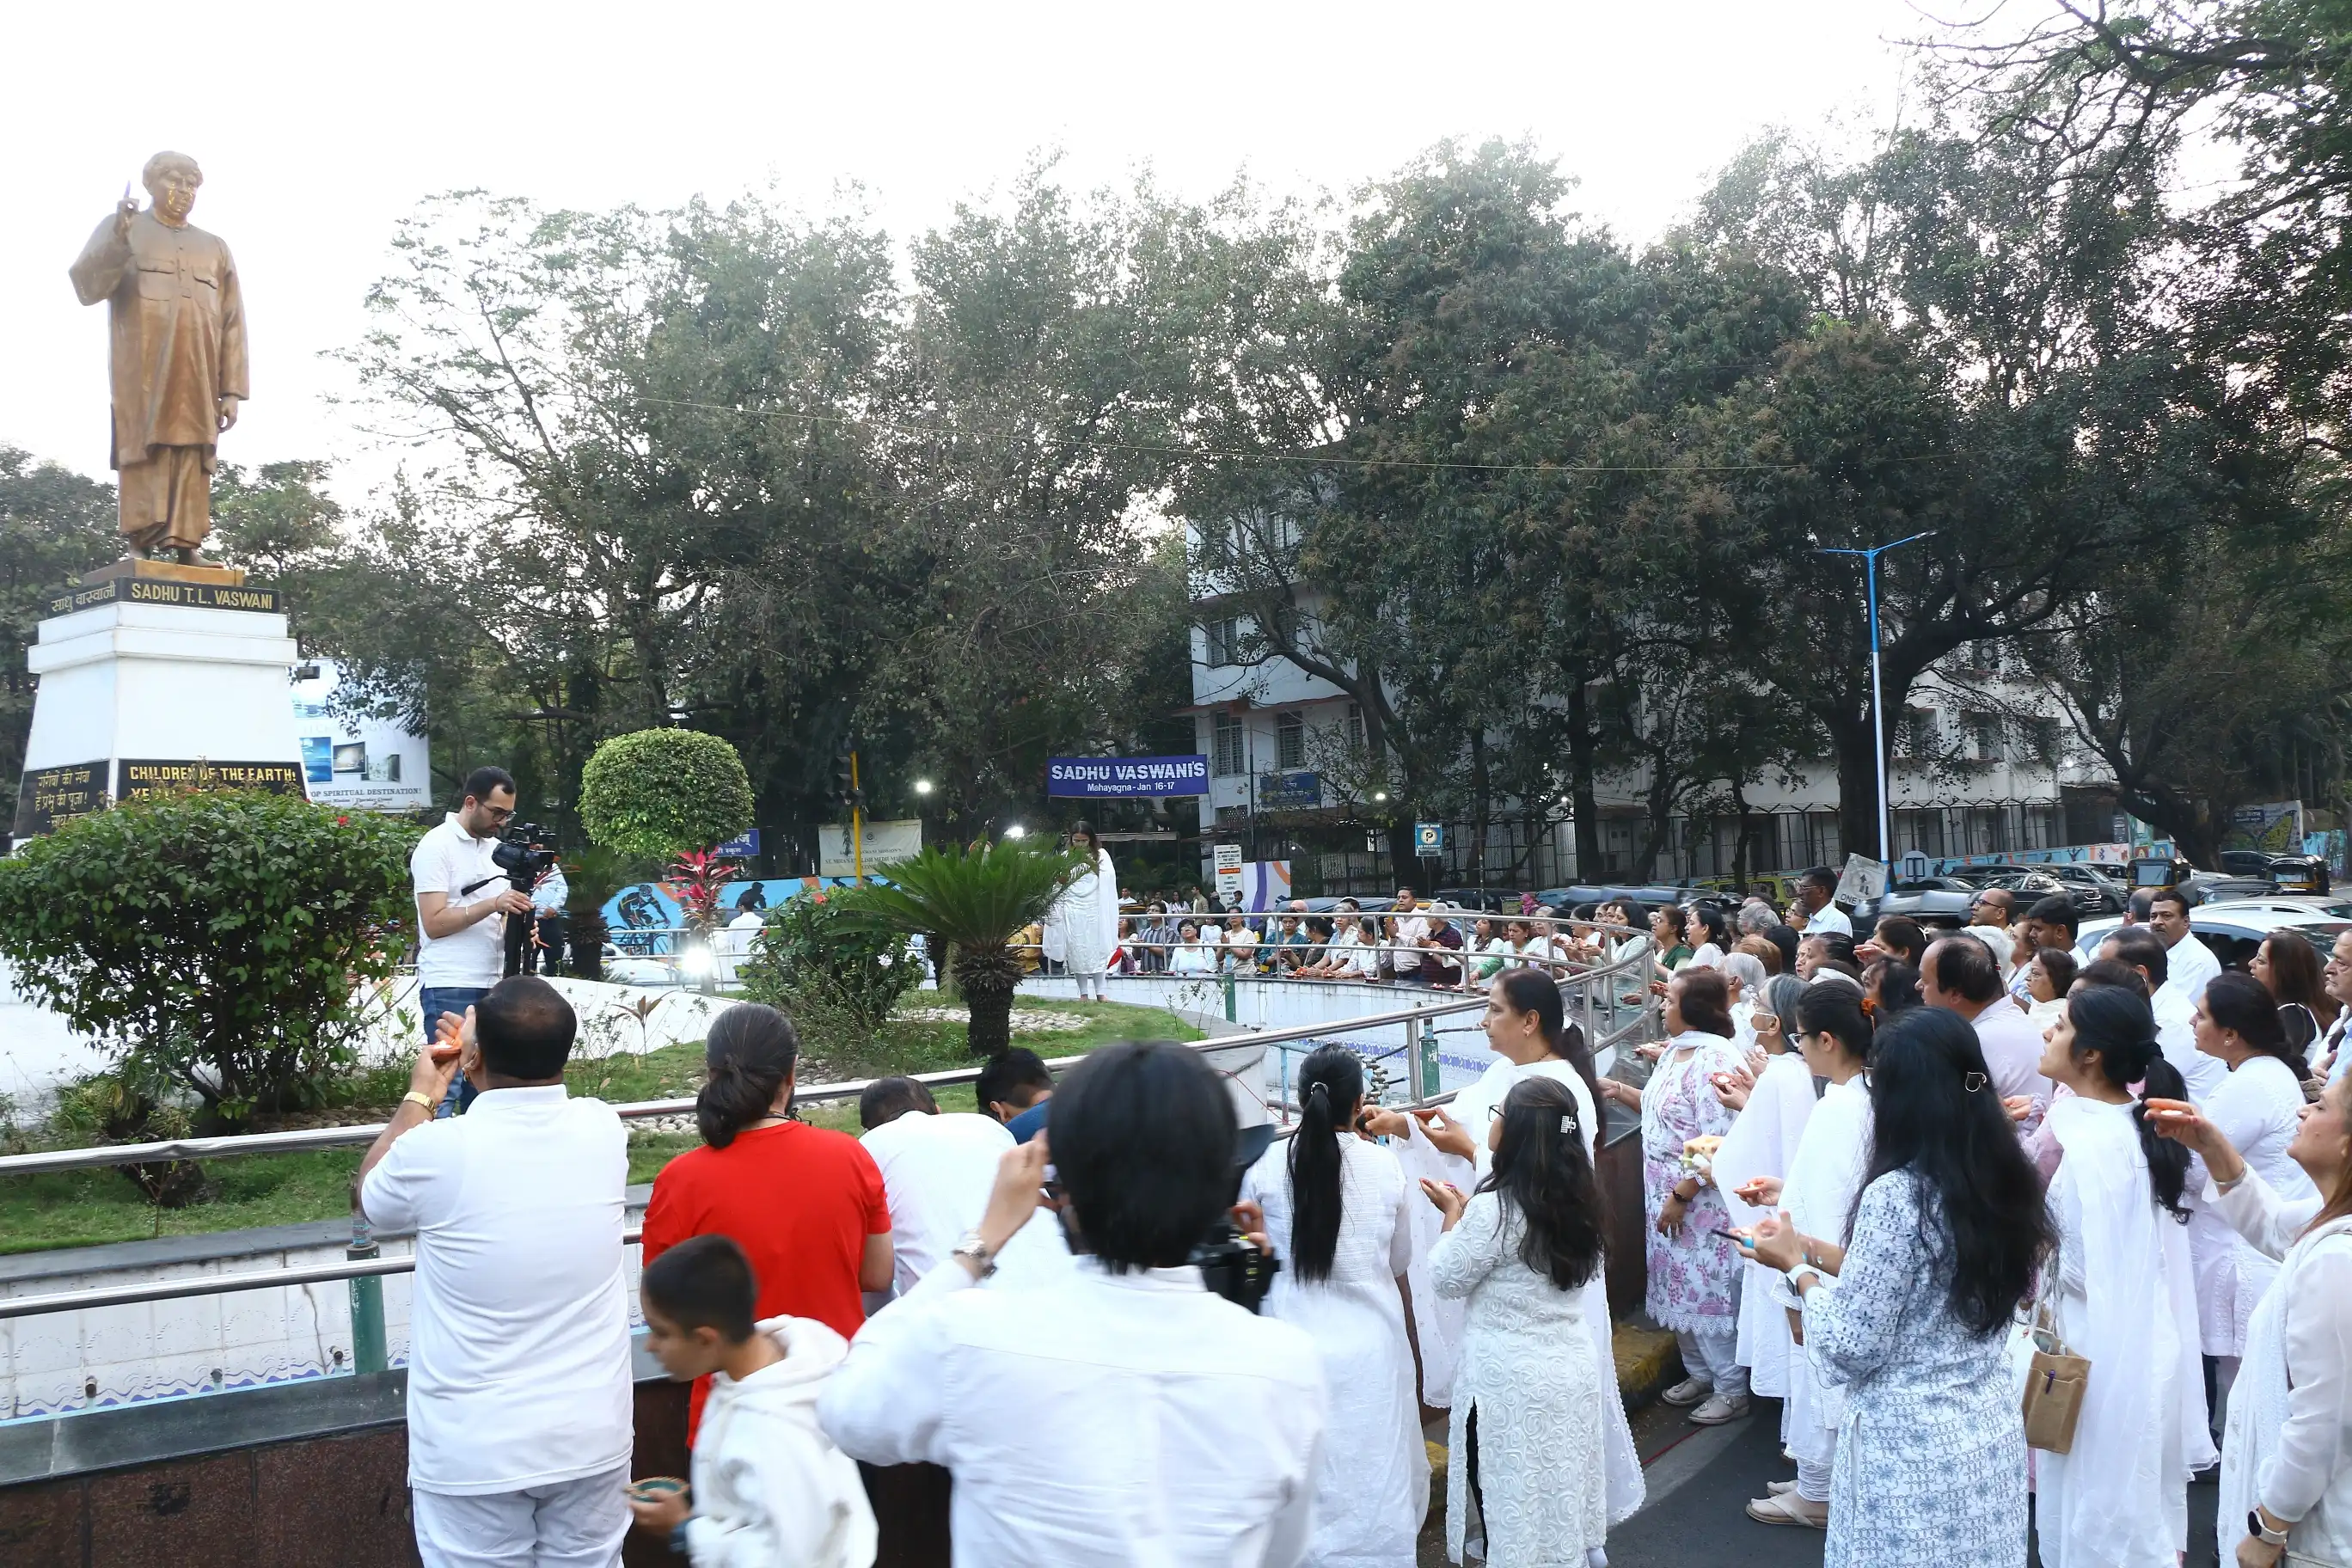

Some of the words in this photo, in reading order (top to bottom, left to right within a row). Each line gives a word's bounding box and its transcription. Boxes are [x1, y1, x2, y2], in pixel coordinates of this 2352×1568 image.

[132, 583, 180, 602] SADHU
[214, 590, 273, 609] VASWANI
[219, 767, 244, 781] THE
[248, 768, 297, 781] EARTH!
[1051, 765, 1110, 780] SADHU
[1116, 761, 1206, 781] VASWANI'S
[1155, 781, 1175, 791] 16-17
[1841, 893, 1857, 905] ONE
